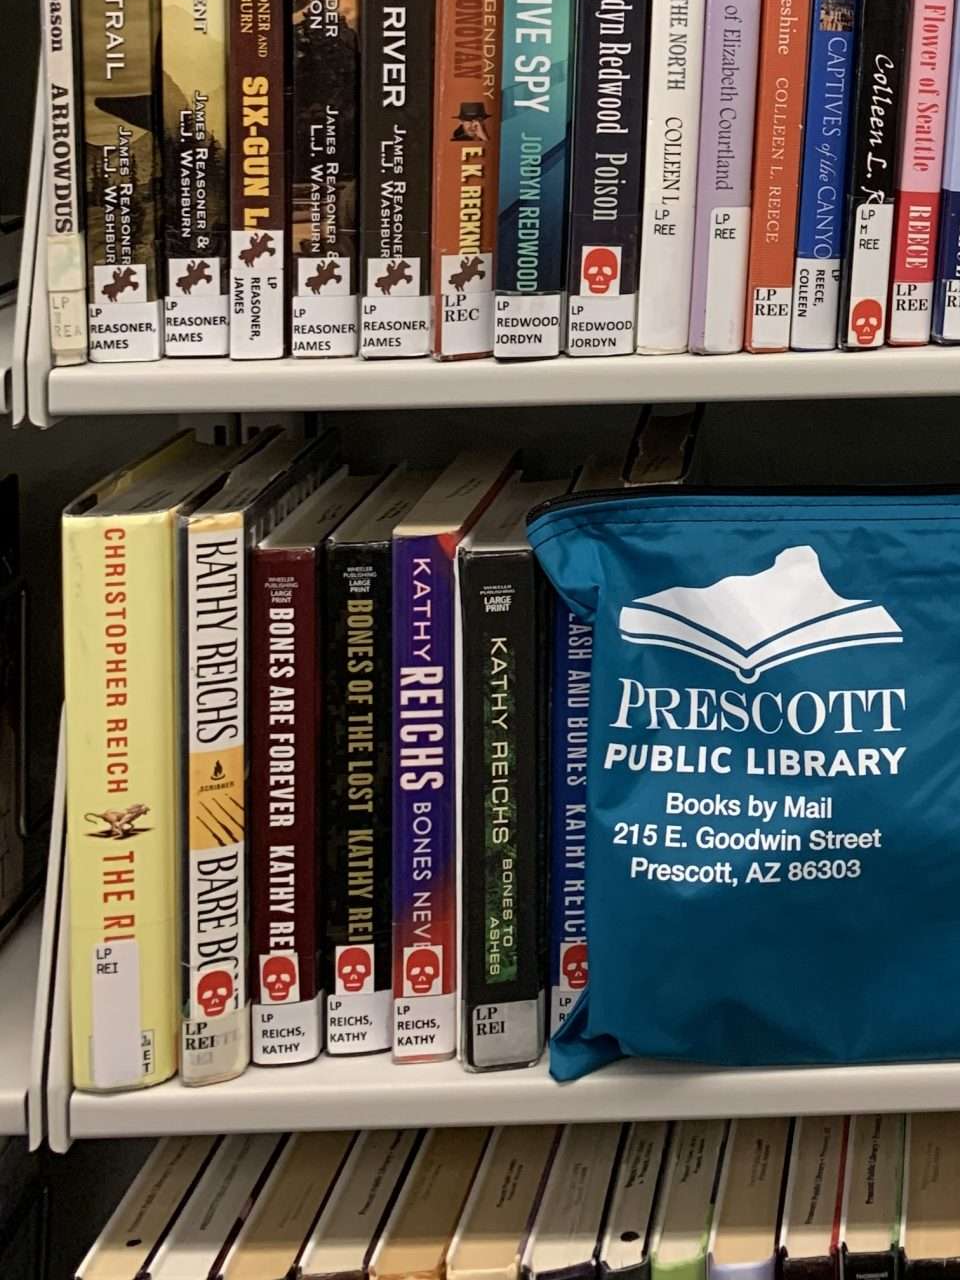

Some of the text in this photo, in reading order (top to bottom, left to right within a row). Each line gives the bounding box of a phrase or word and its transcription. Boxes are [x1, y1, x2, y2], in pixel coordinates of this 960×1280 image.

[724, 4, 742, 22] of
[382, 6, 407, 108] RIVER
[514, 55, 551, 113] SPY
[596, 39, 631, 135] Redwood
[719, 28, 741, 102] Elizabeth
[51, 84, 73, 233] ARROWDUS
[714, 106, 736, 191] Courtland
[592, 151, 627, 221] Poison
[102, 528, 129, 794] CHRISTOPHER REICH
[195, 536, 240, 745] KATHY REICHS
[400, 558, 445, 791] KATHY REICHS
[346, 599, 374, 813] BONES OF THE LOST
[609, 678, 907, 735] PRESCOTT
[604, 744, 907, 777] PUBLIC LIBRARY
[613, 824, 881, 851] 215 E. Goodwin Street
[665, 793, 833, 822] Books by Mail
[630, 857, 861, 887] Prescott, AZ 86303
